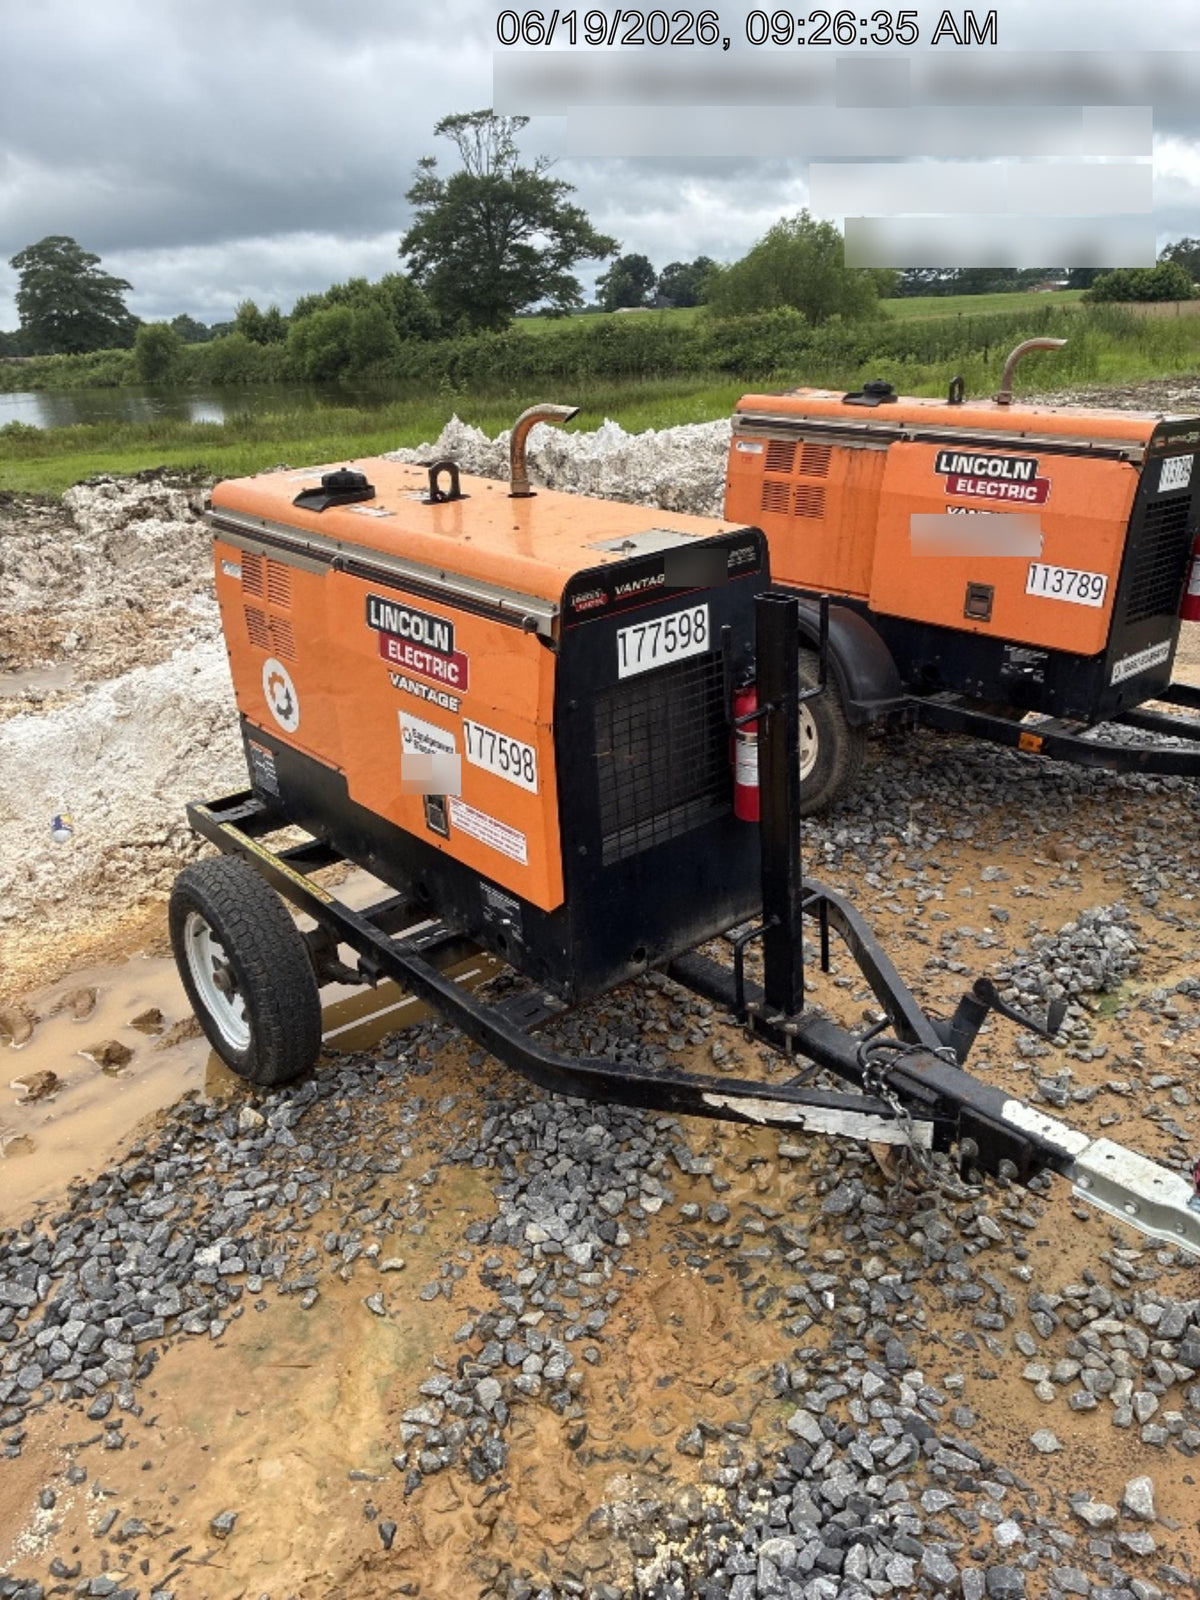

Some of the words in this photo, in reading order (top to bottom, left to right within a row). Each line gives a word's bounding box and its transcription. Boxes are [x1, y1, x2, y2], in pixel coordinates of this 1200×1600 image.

[939, 453, 1033, 480] LINCOLN
[956, 479, 1038, 500] ELECTRIC
[615, 573, 665, 595] VANTAG
[1029, 564, 1104, 600] 113789
[369, 600, 450, 652] LINCOLN
[617, 608, 707, 667] 177598
[387, 639, 460, 684] ELECTRIC
[388, 671, 461, 713] VANTAGE
[463, 720, 535, 783] 177598
